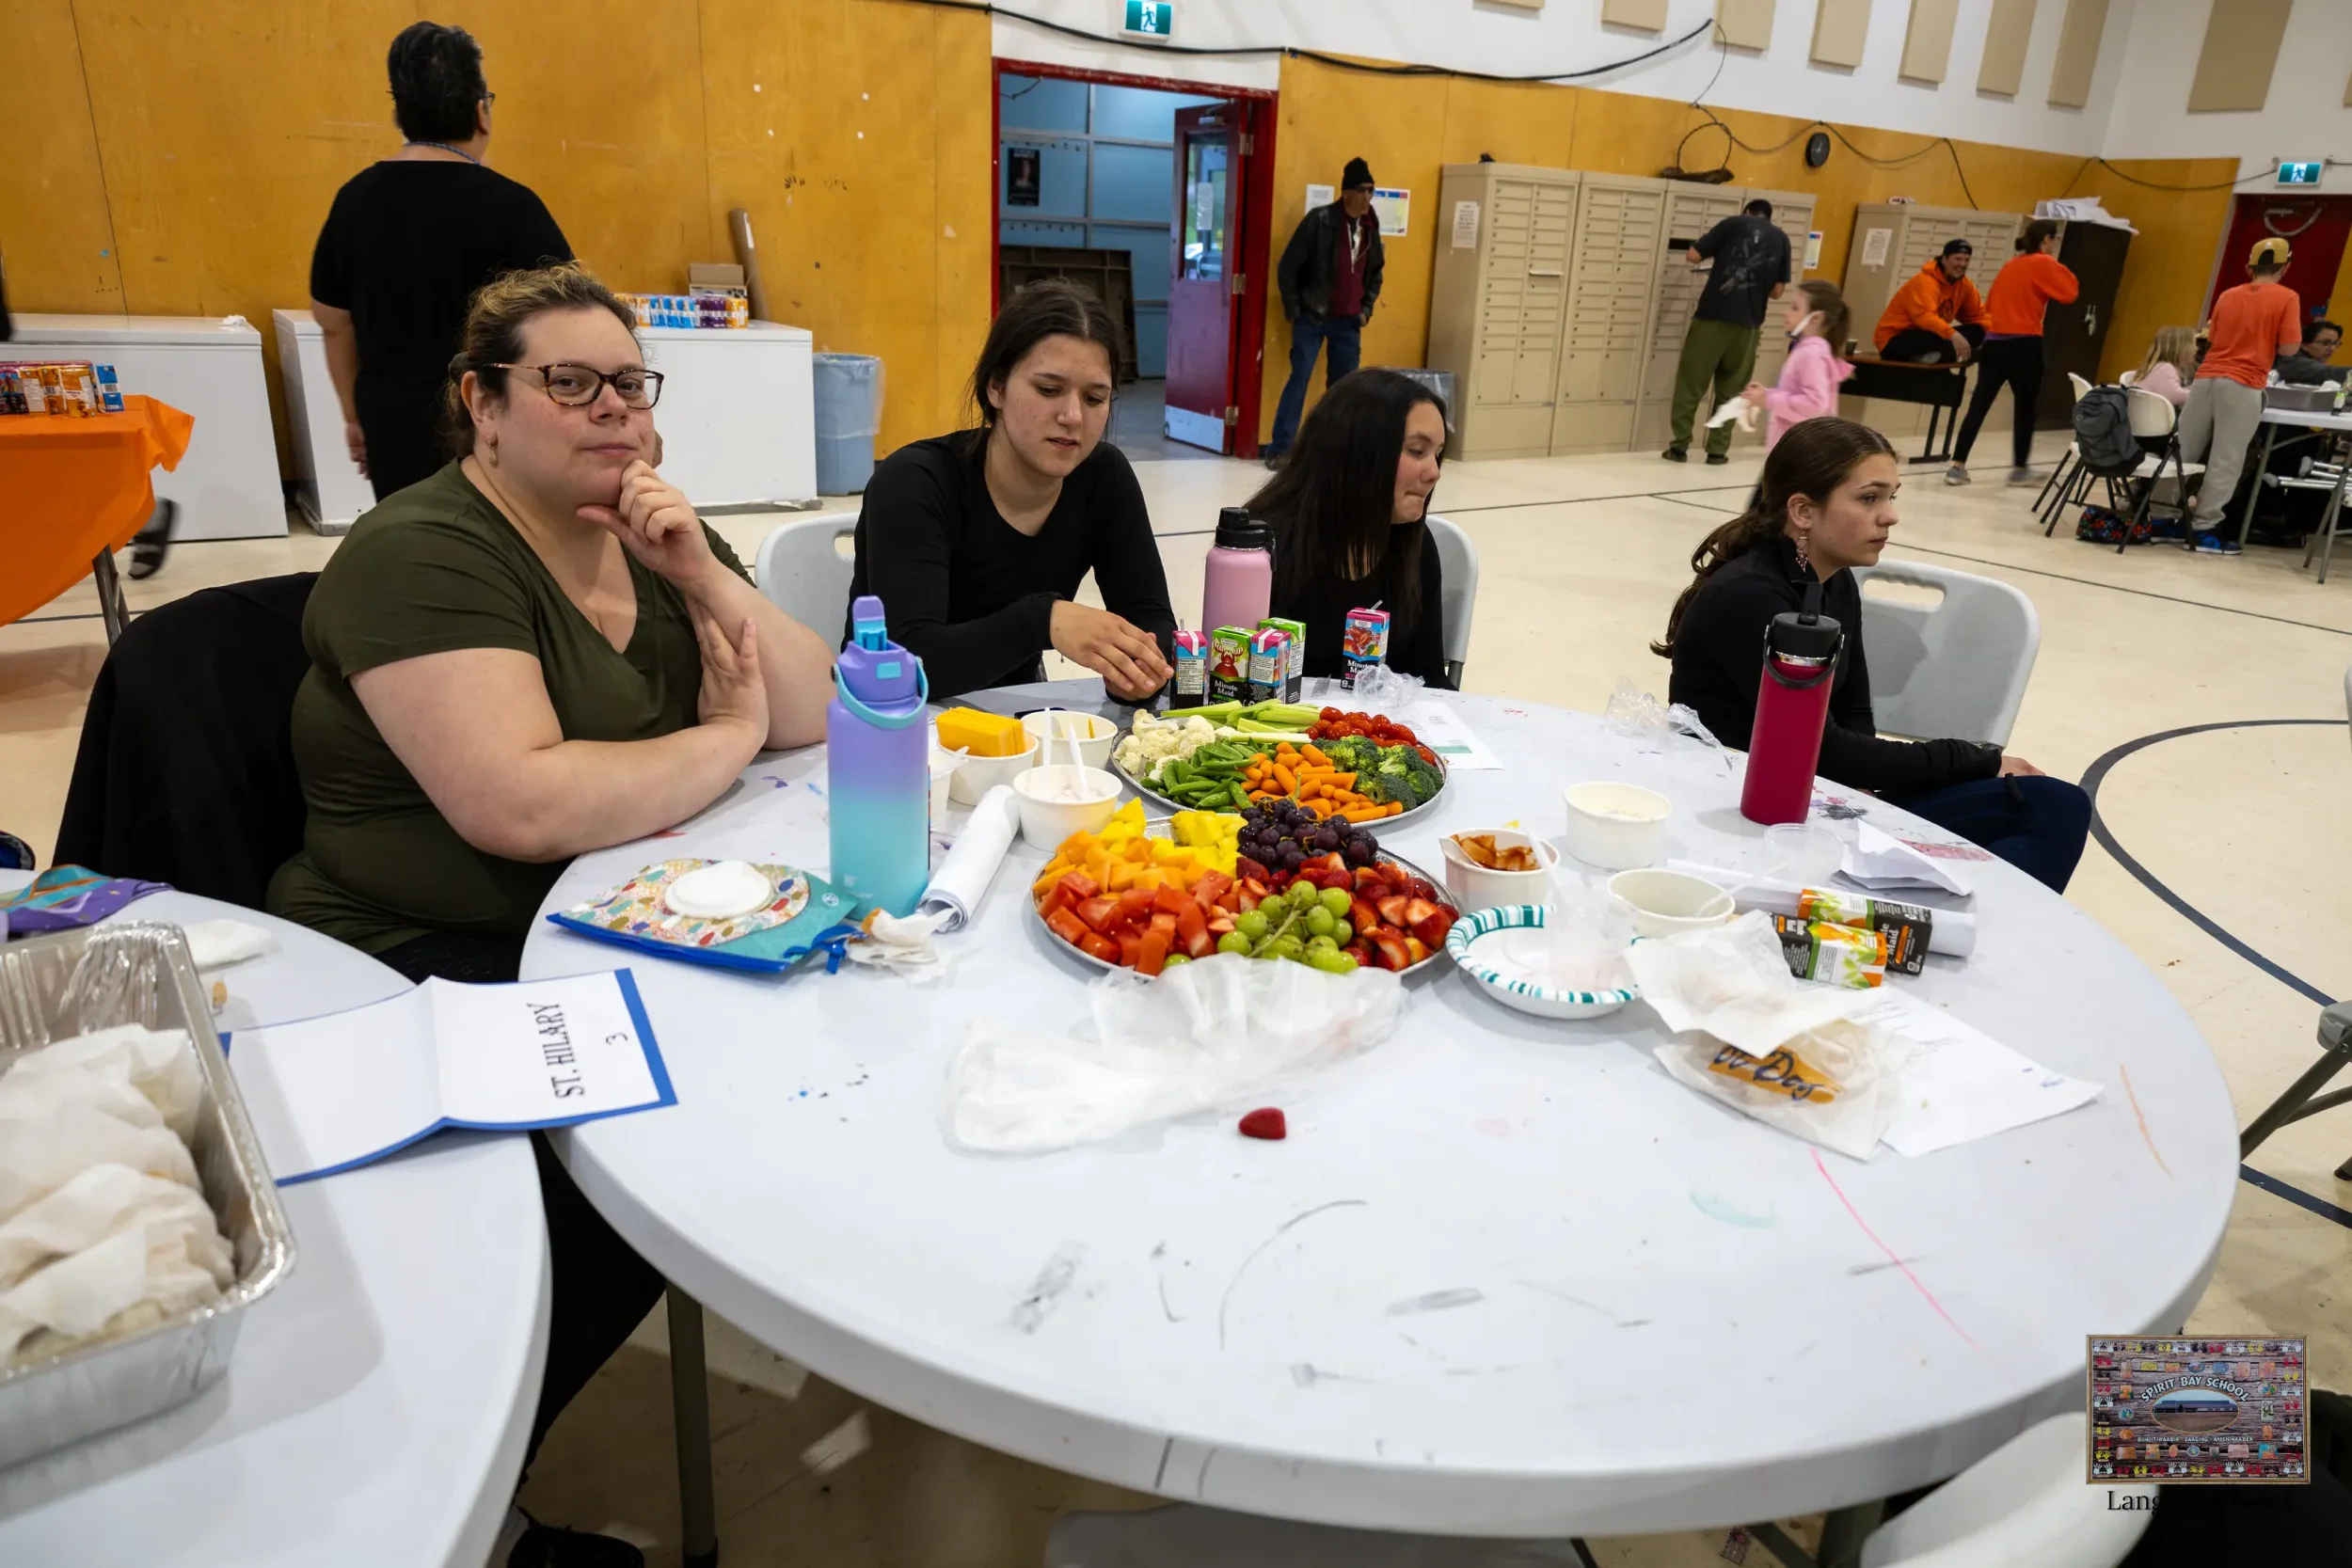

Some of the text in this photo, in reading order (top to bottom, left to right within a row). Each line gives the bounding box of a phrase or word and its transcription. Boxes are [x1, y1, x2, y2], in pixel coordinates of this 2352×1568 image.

[525, 1002, 586, 1100] ST. HILARY
[605, 1032, 628, 1046] 3
[1752, 1050, 1824, 1101] Dog
